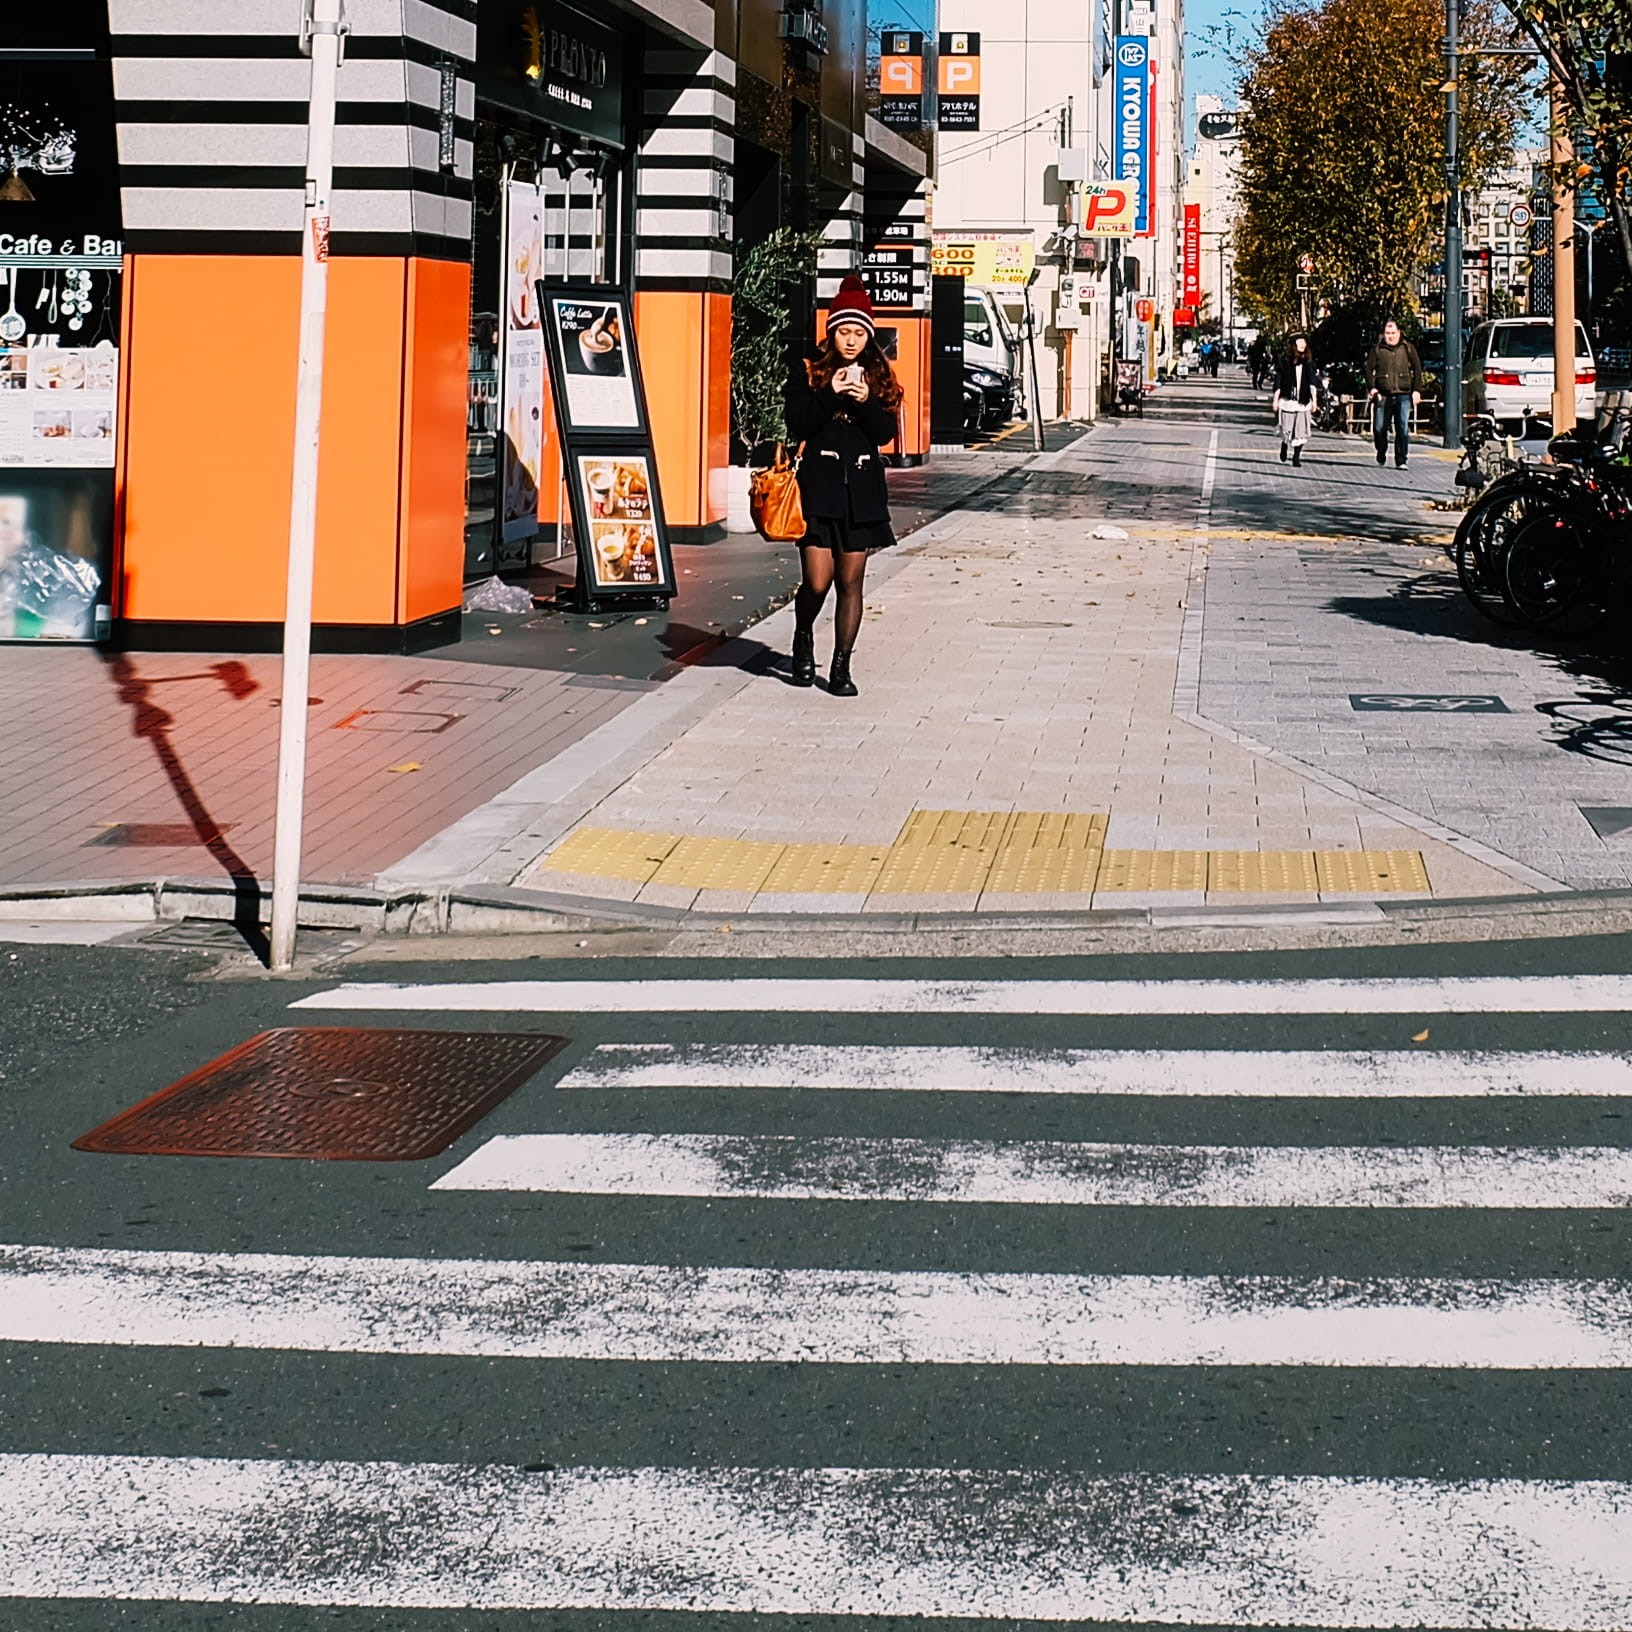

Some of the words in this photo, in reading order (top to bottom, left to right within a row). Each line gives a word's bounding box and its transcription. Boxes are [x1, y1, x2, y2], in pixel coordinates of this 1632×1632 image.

[947, 61, 973, 90] P
[1122, 77, 1141, 150] KYOWA
[1085, 185, 1106, 195] 24h
[1086, 189, 1126, 231] P
[0, 234, 52, 255] Cafe
